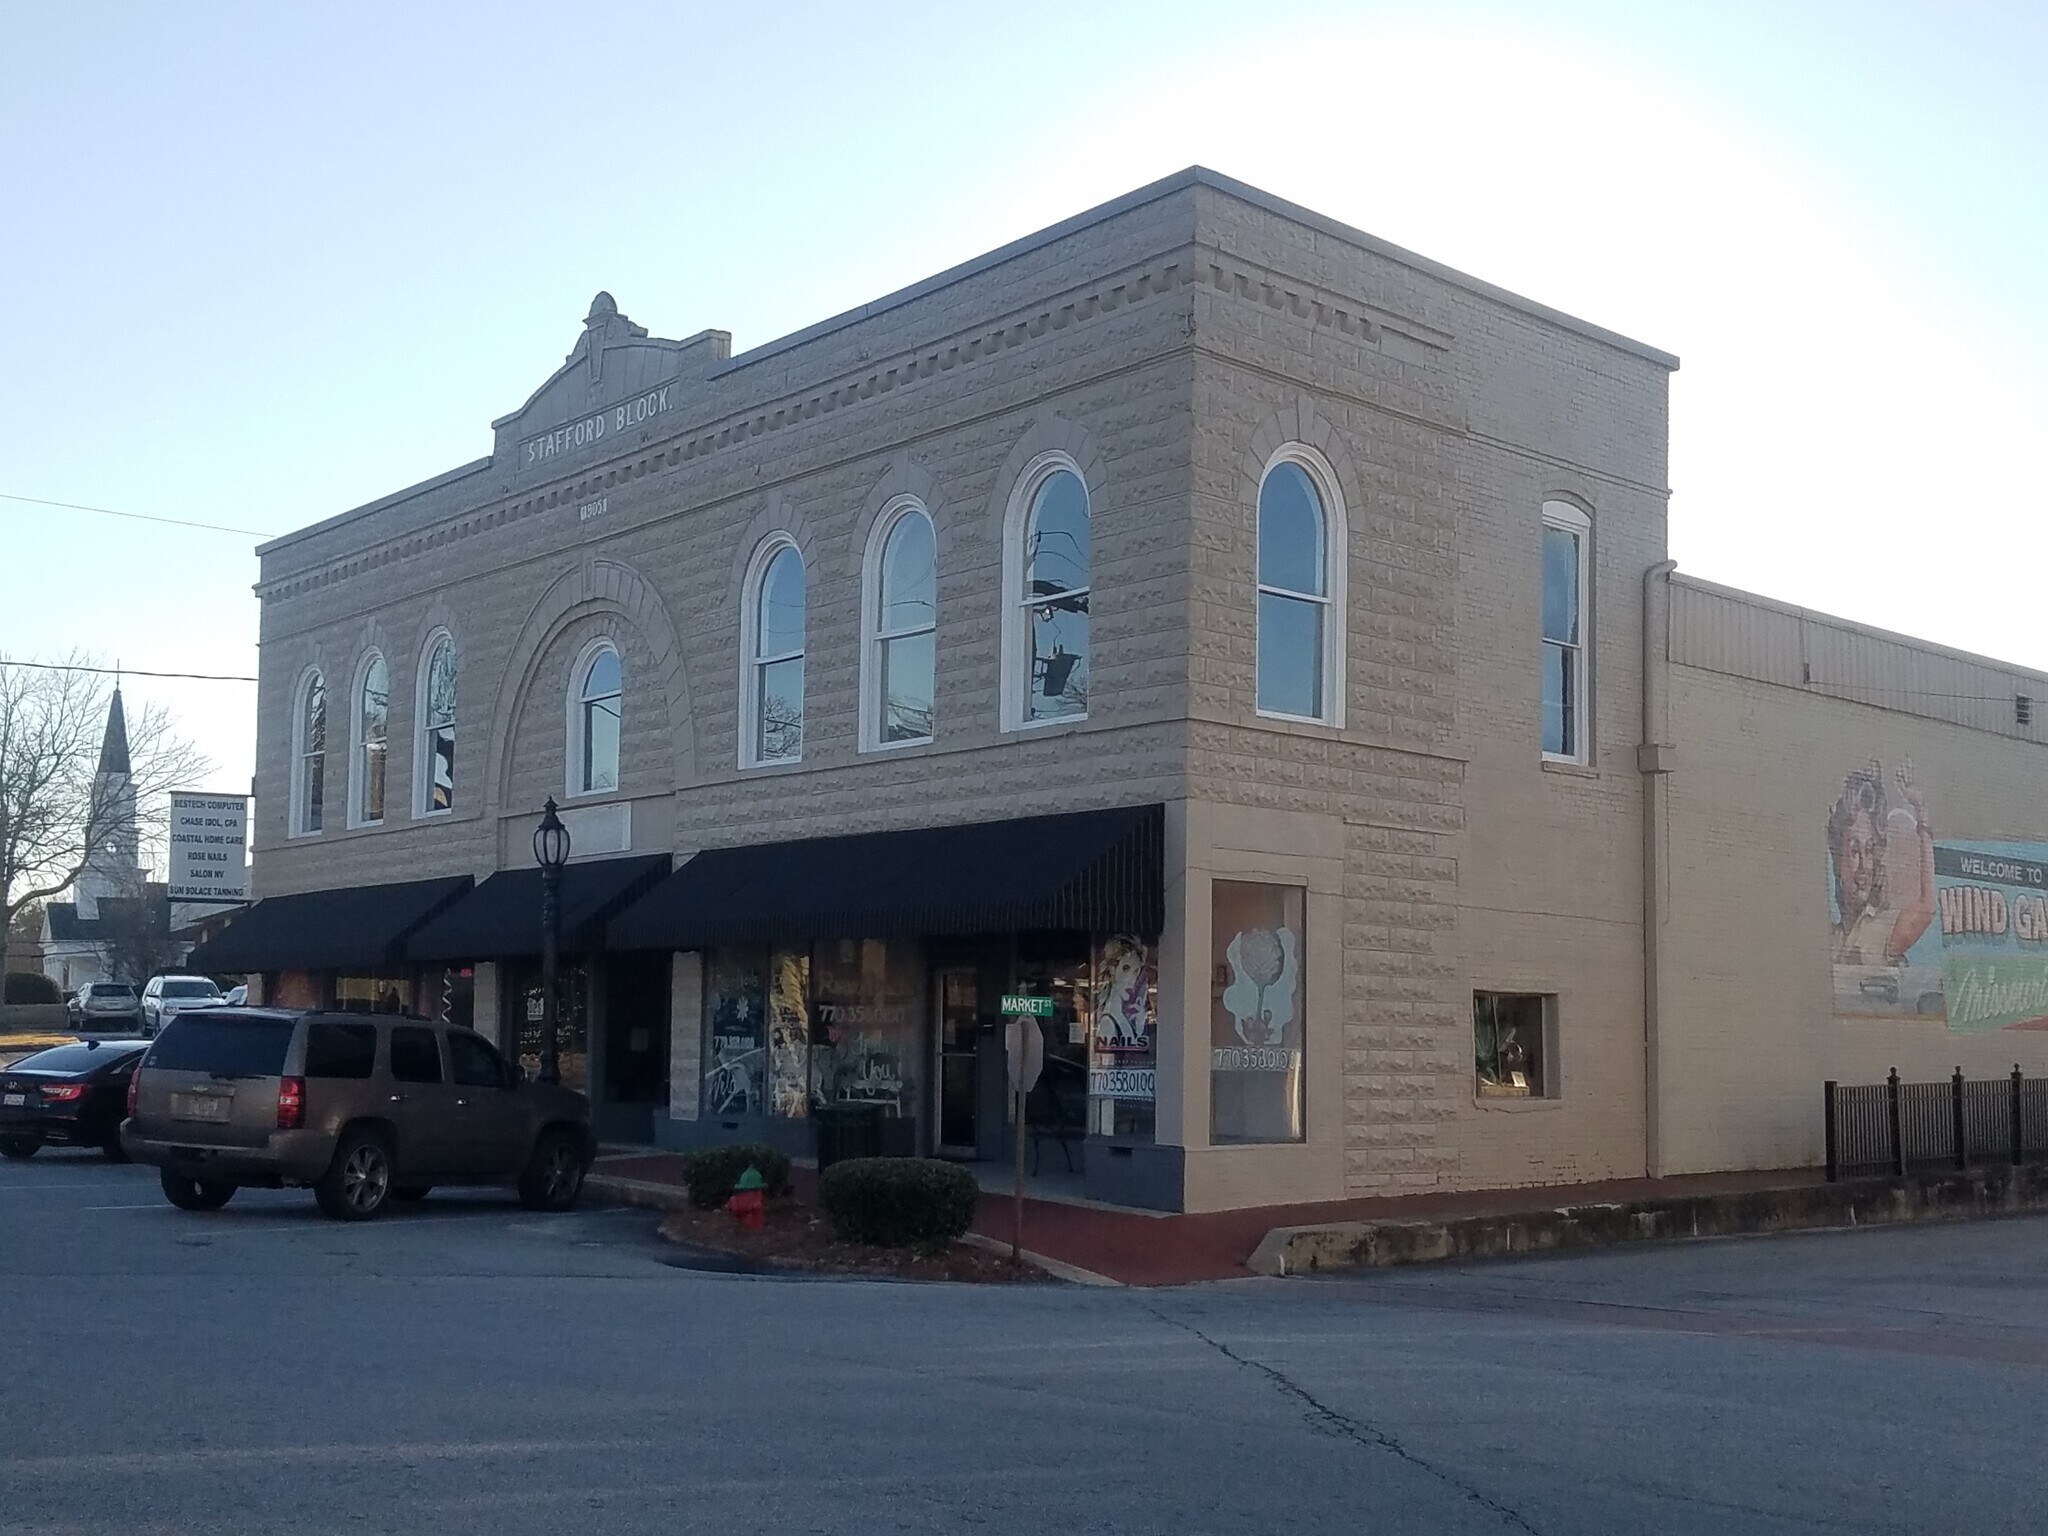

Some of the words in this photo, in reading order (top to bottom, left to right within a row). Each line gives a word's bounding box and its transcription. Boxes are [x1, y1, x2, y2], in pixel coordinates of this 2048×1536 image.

[527, 414, 606, 463] STAFFORD
[207, 802, 244, 811] COMPUTER
[180, 817, 203, 826] CHASE
[224, 820, 237, 828] CPA
[172, 835, 202, 844] COASTAL
[204, 835, 223, 844] HOME
[225, 837, 243, 845] CARE
[187, 852, 205, 861] ROSE
[207, 853, 227, 862] NAILS
[189, 870, 212, 879] SALON
[1960, 856, 2023, 882] WELCOME
[2026, 867, 2043, 884] TO
[169, 886, 184, 895] SUN
[185, 887, 212, 896] SOLACE
[213, 888, 243, 897] TANNING
[1940, 887, 2008, 935] WIND
[1001, 996, 1044, 1014] MARKET
[1095, 1036, 1149, 1047] NAILS
